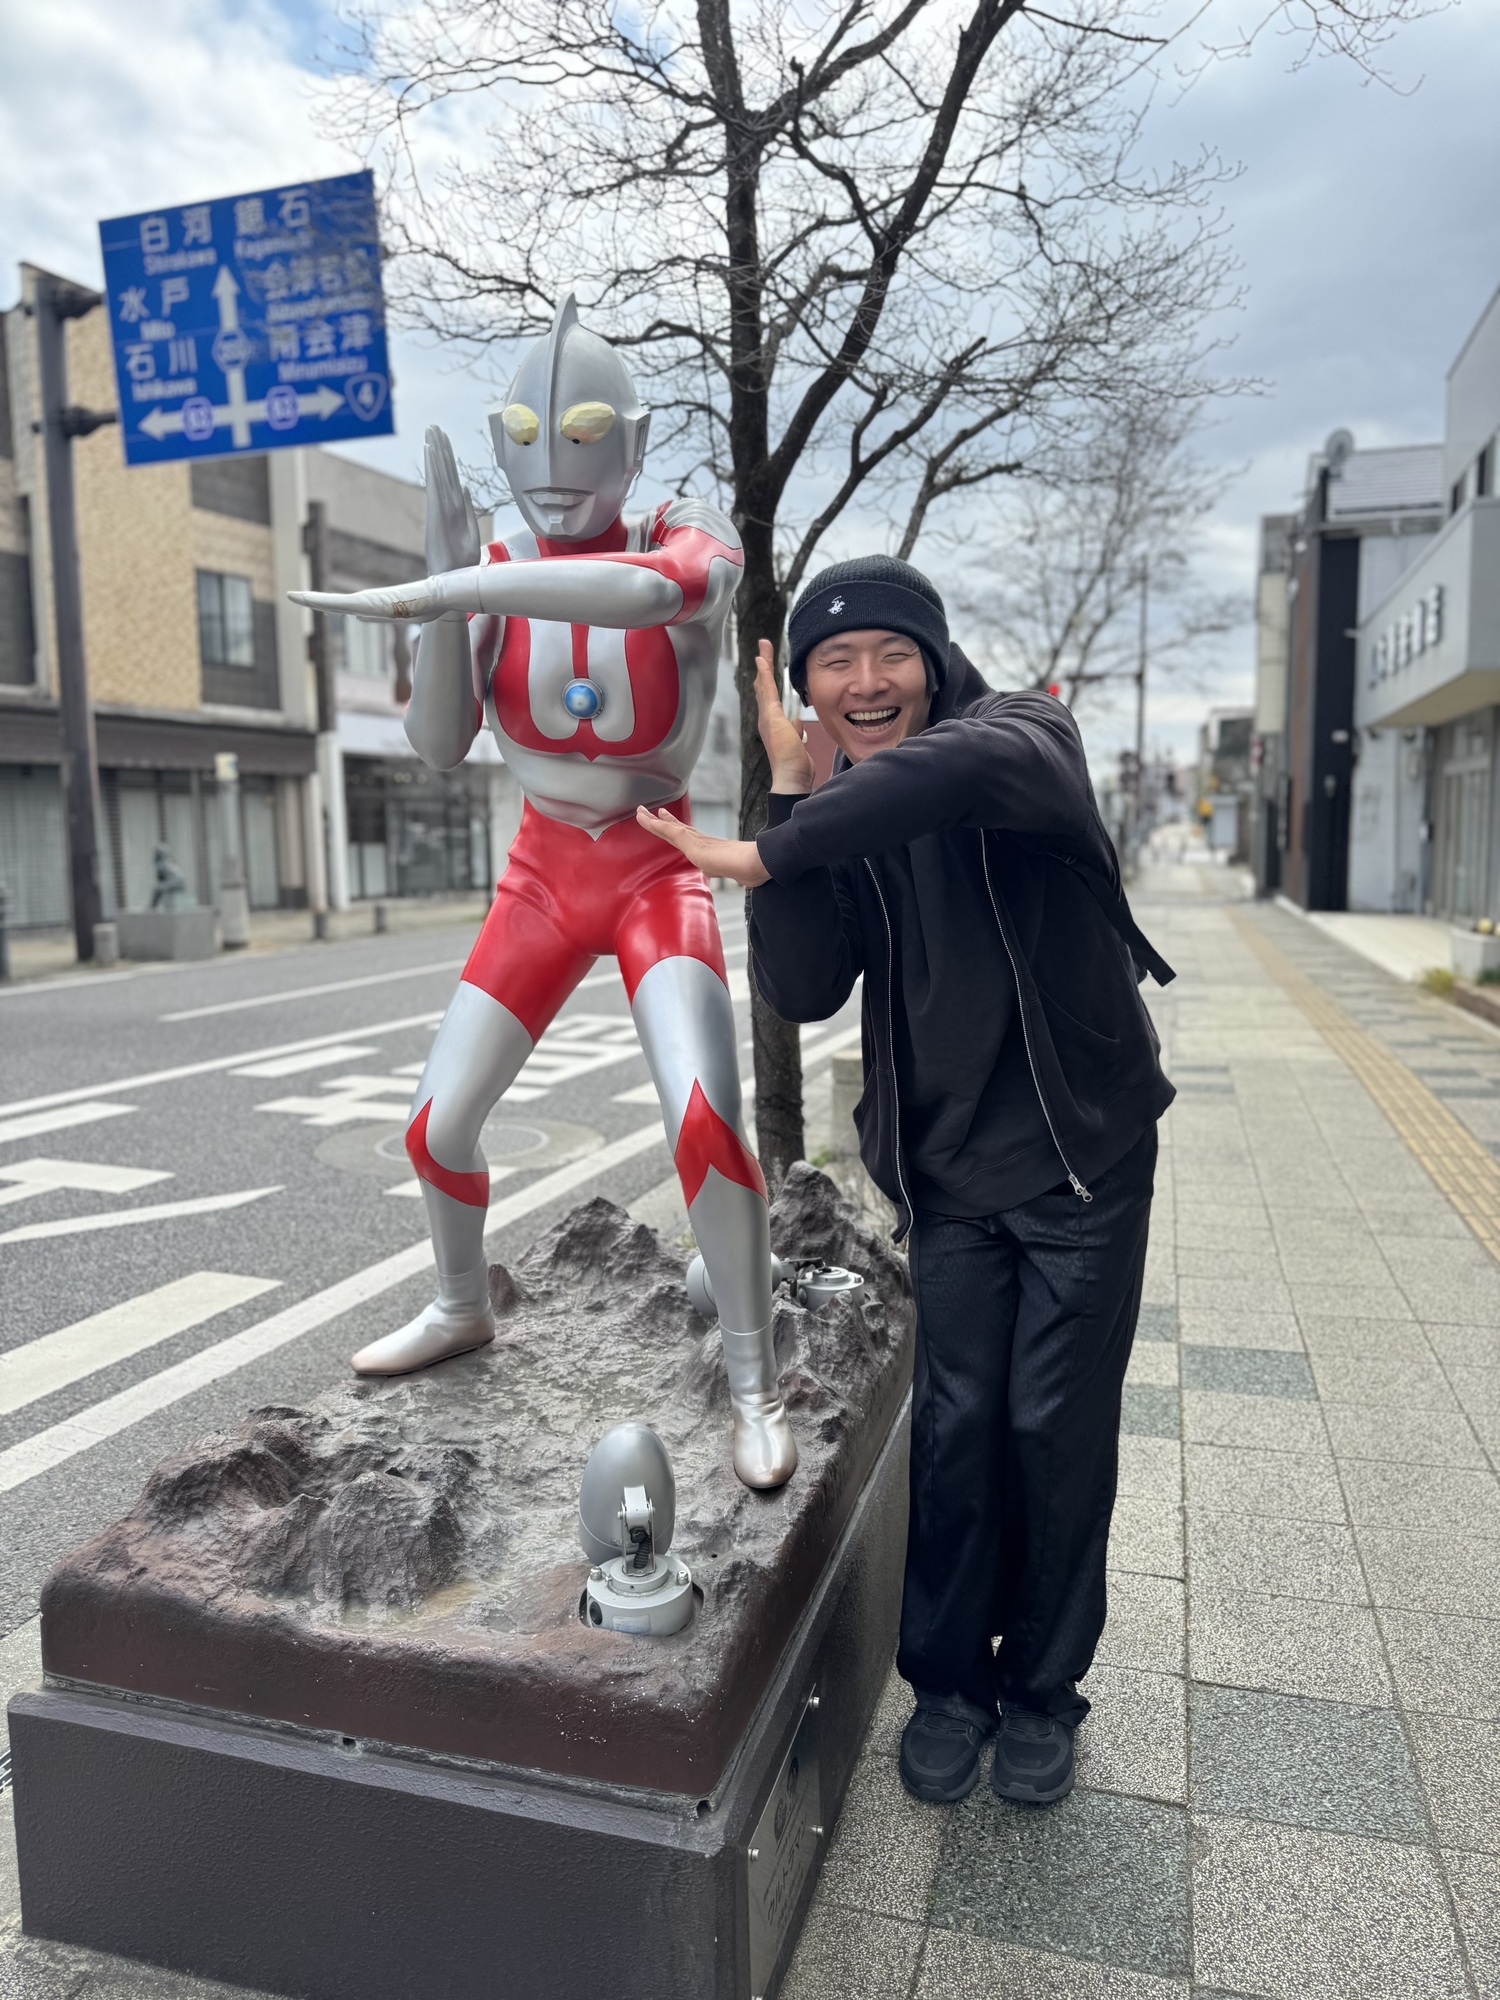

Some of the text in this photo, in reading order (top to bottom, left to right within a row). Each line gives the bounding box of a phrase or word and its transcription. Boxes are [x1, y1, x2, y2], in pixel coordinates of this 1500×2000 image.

[140, 206, 212, 254] 白河
[144, 247, 217, 275] Shirakawa
[118, 276, 190, 322] 水戸
[140, 320, 176, 342] Mito
[269, 314, 373, 361] 南会津
[124, 337, 198, 380] 石川
[132, 377, 197, 401] Ishikawa
[356, 384, 374, 407] 4
[767, 1811, 808, 1928] ウルトラマン
